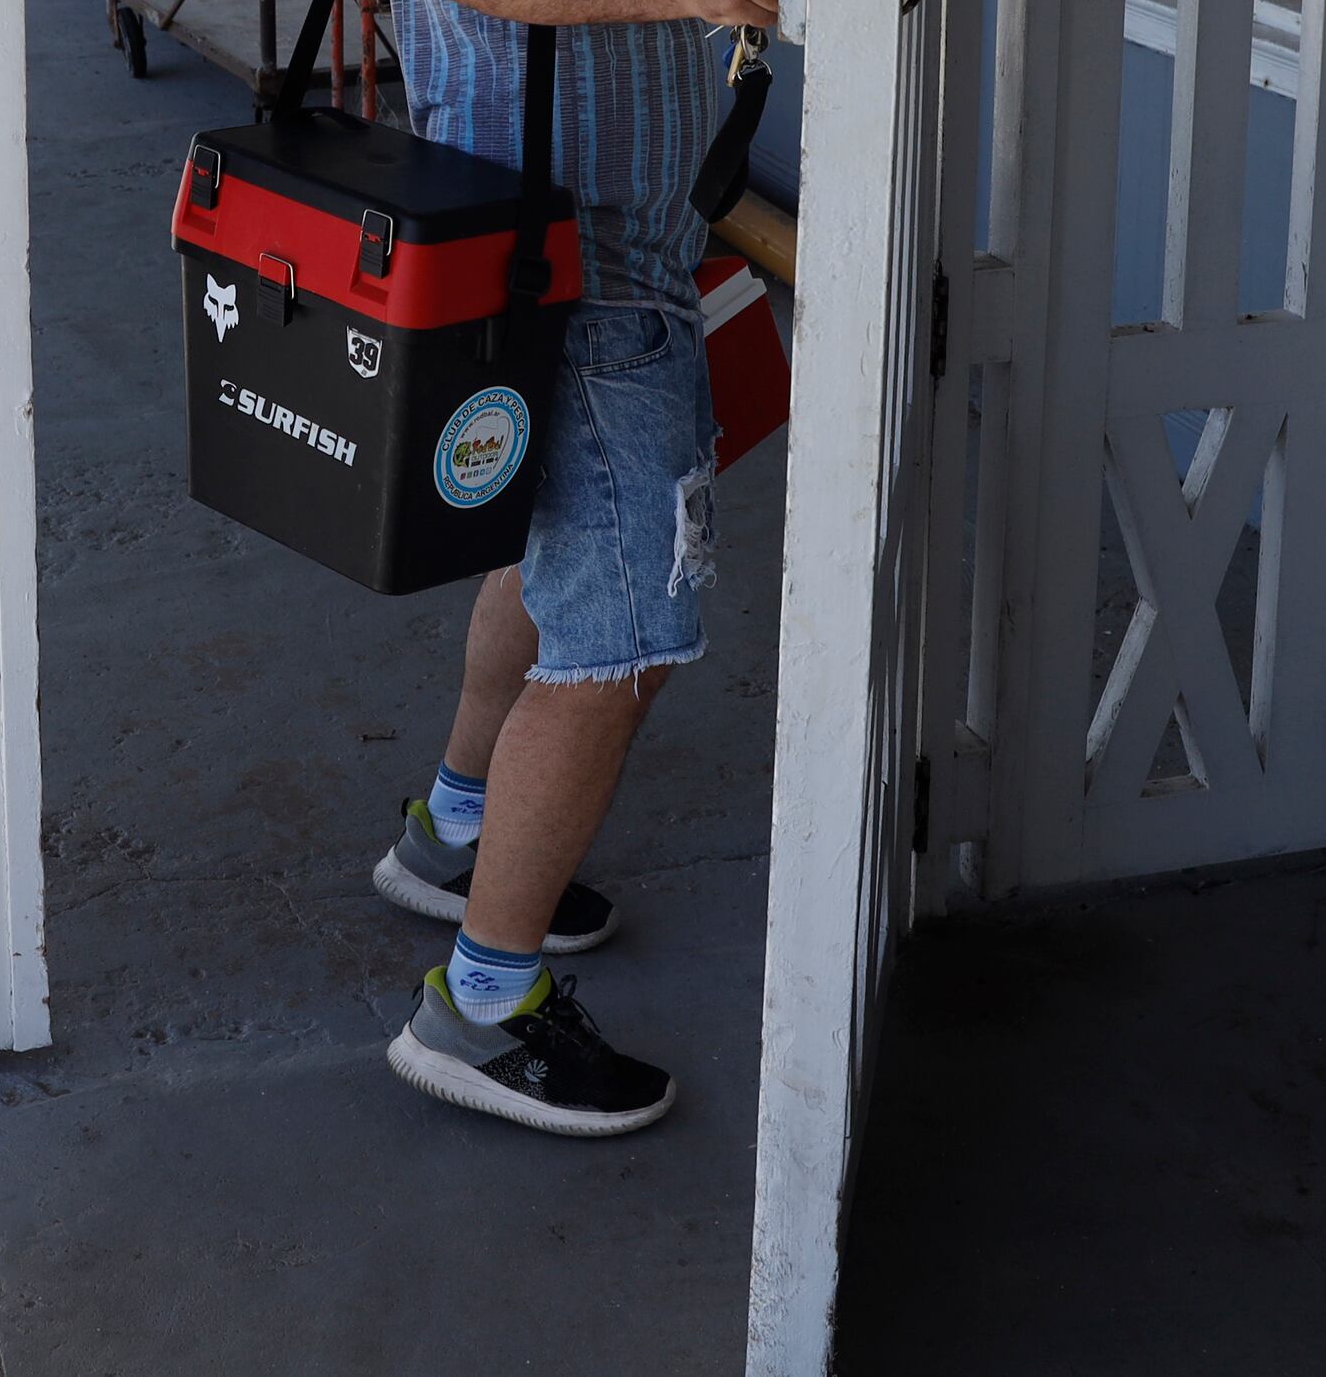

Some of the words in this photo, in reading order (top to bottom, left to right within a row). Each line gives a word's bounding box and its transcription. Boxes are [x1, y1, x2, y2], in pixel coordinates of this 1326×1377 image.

[349, 337, 379, 372] 39
[237, 388, 358, 467] SURFISH
[442, 418, 462, 452] CLUB
[462, 403, 476, 419] DE
[478, 393, 504, 407] CAZA
[505, 395, 513, 405] Y
[511, 401, 525, 436] PESCA
[475, 464, 514, 498] ARGENTINA
